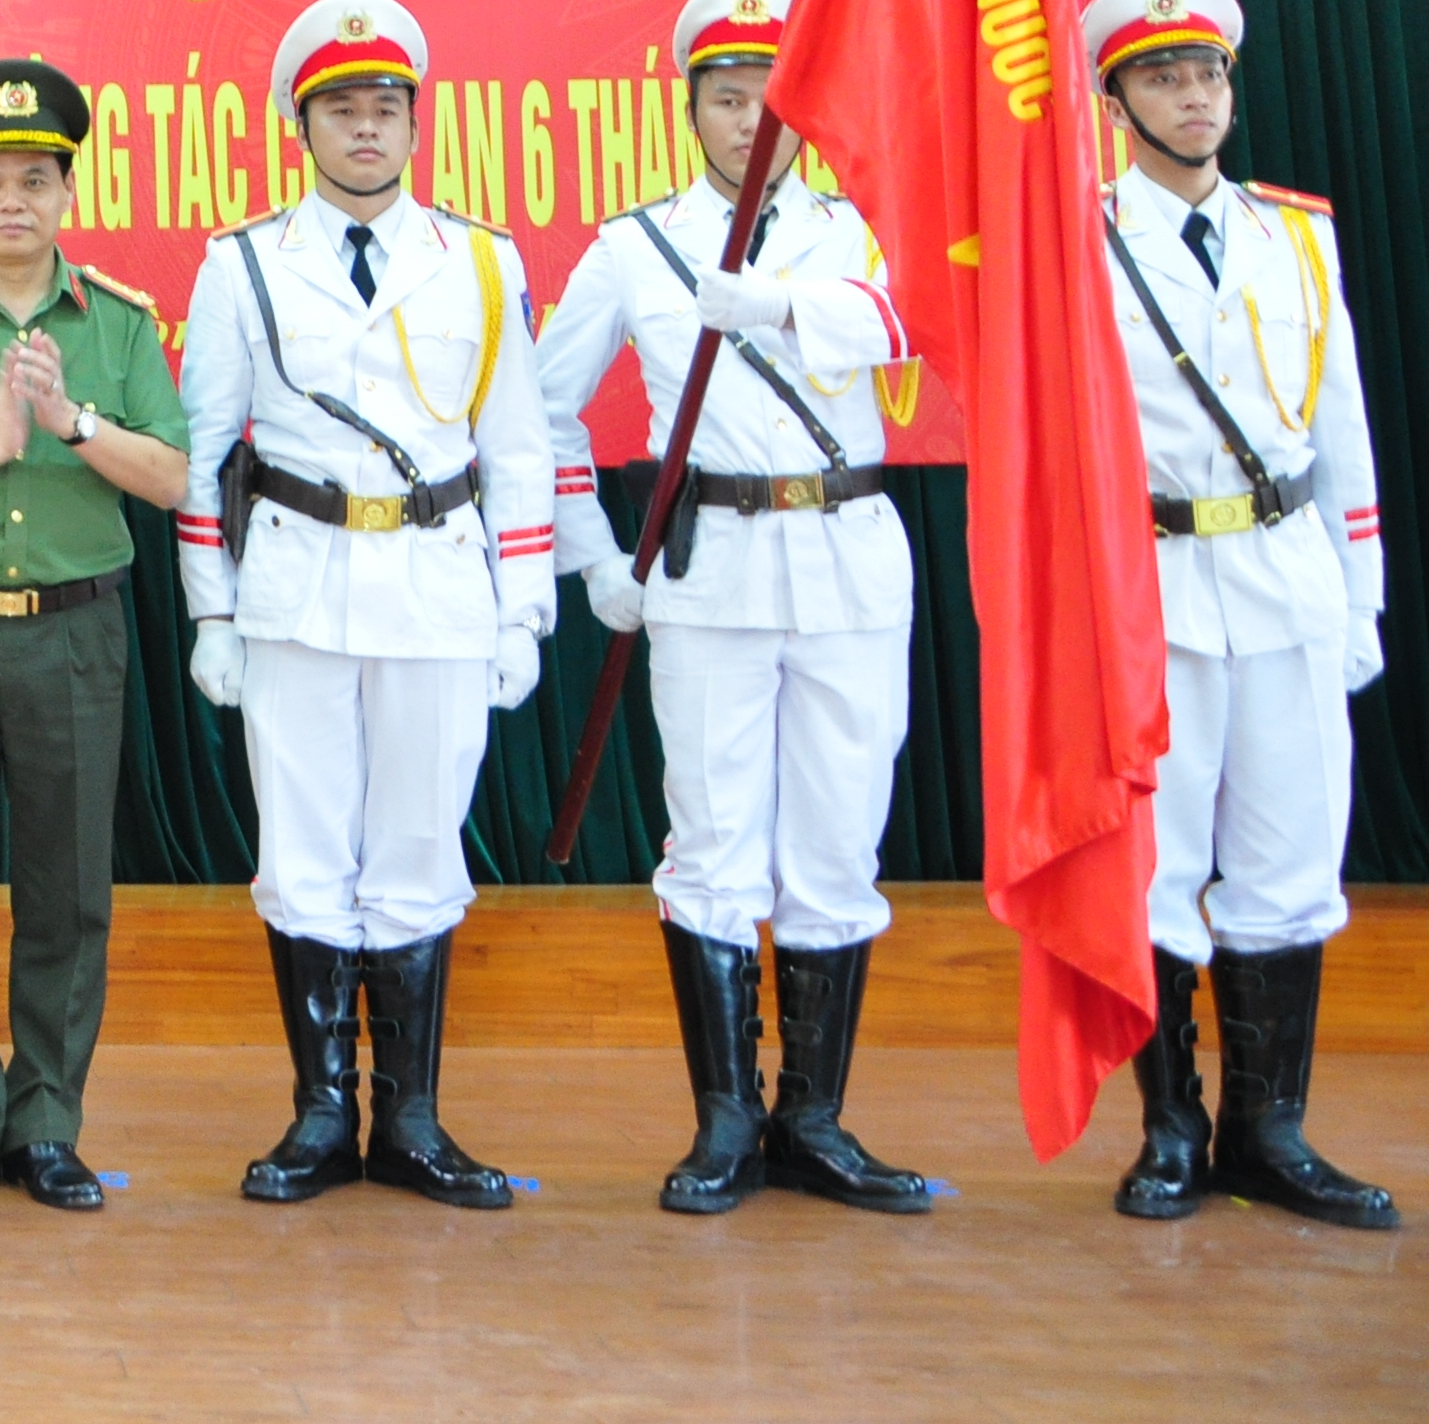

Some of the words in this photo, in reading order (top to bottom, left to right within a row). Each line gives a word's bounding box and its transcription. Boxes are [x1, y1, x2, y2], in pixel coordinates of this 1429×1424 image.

[145, 51, 248, 229] TÁC
[431, 79, 508, 226] AN
[521, 79, 556, 228] 6
